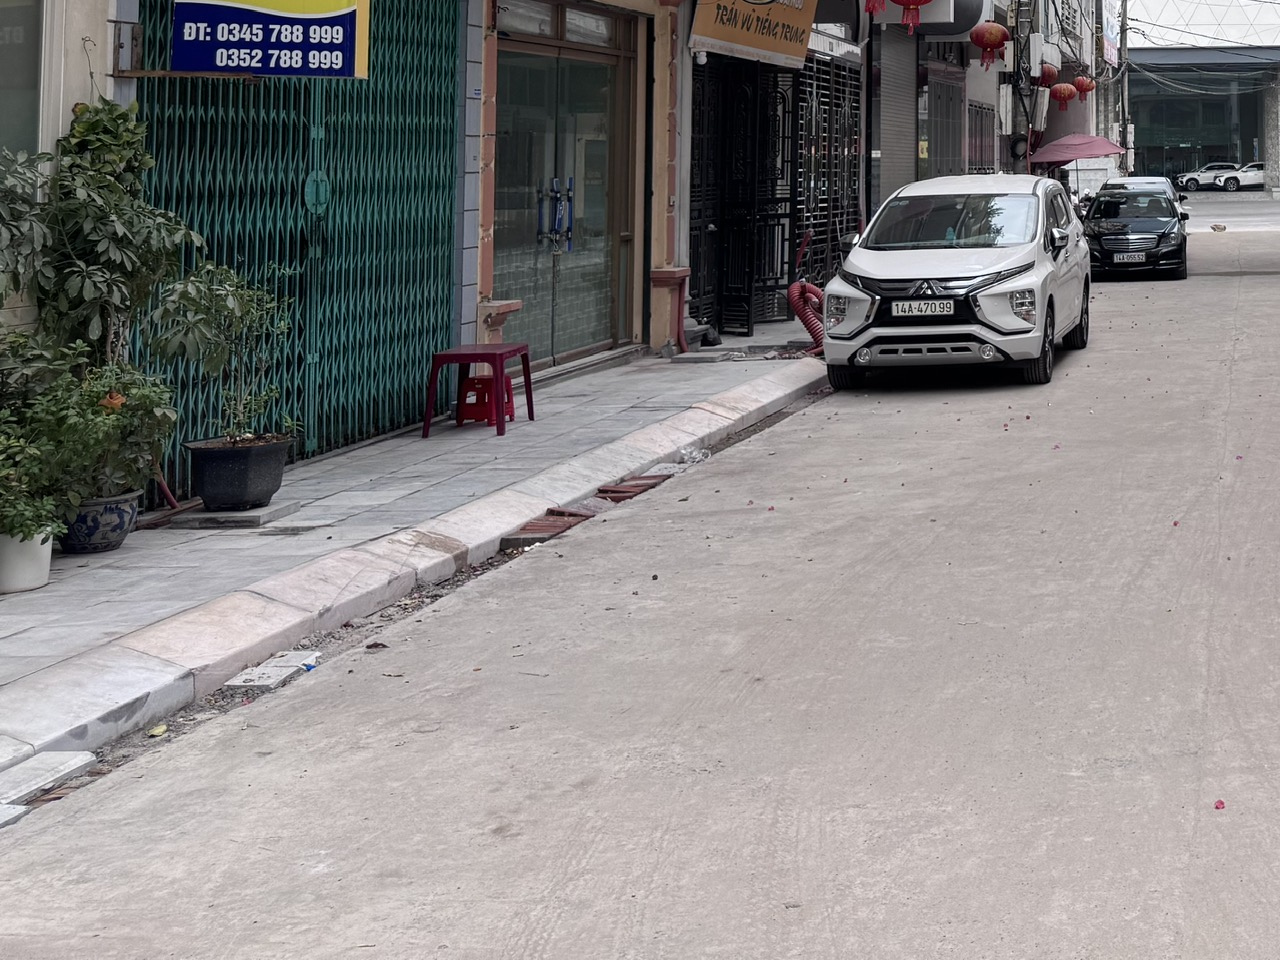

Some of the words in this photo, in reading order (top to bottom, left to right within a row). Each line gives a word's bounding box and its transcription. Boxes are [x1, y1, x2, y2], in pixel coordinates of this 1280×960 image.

[183, 22, 212, 41] ĐT:
[216, 23, 263, 42] 0345
[268, 24, 304, 43] 788
[309, 25, 344, 44] 999
[754, 7, 780, 39] TIẾNG
[779, 24, 806, 45] TRUNG
[215, 48, 263, 67] 0352
[267, 49, 303, 68] 788
[308, 50, 344, 69] 999
[895, 301, 952, 315] 14A-470.99
